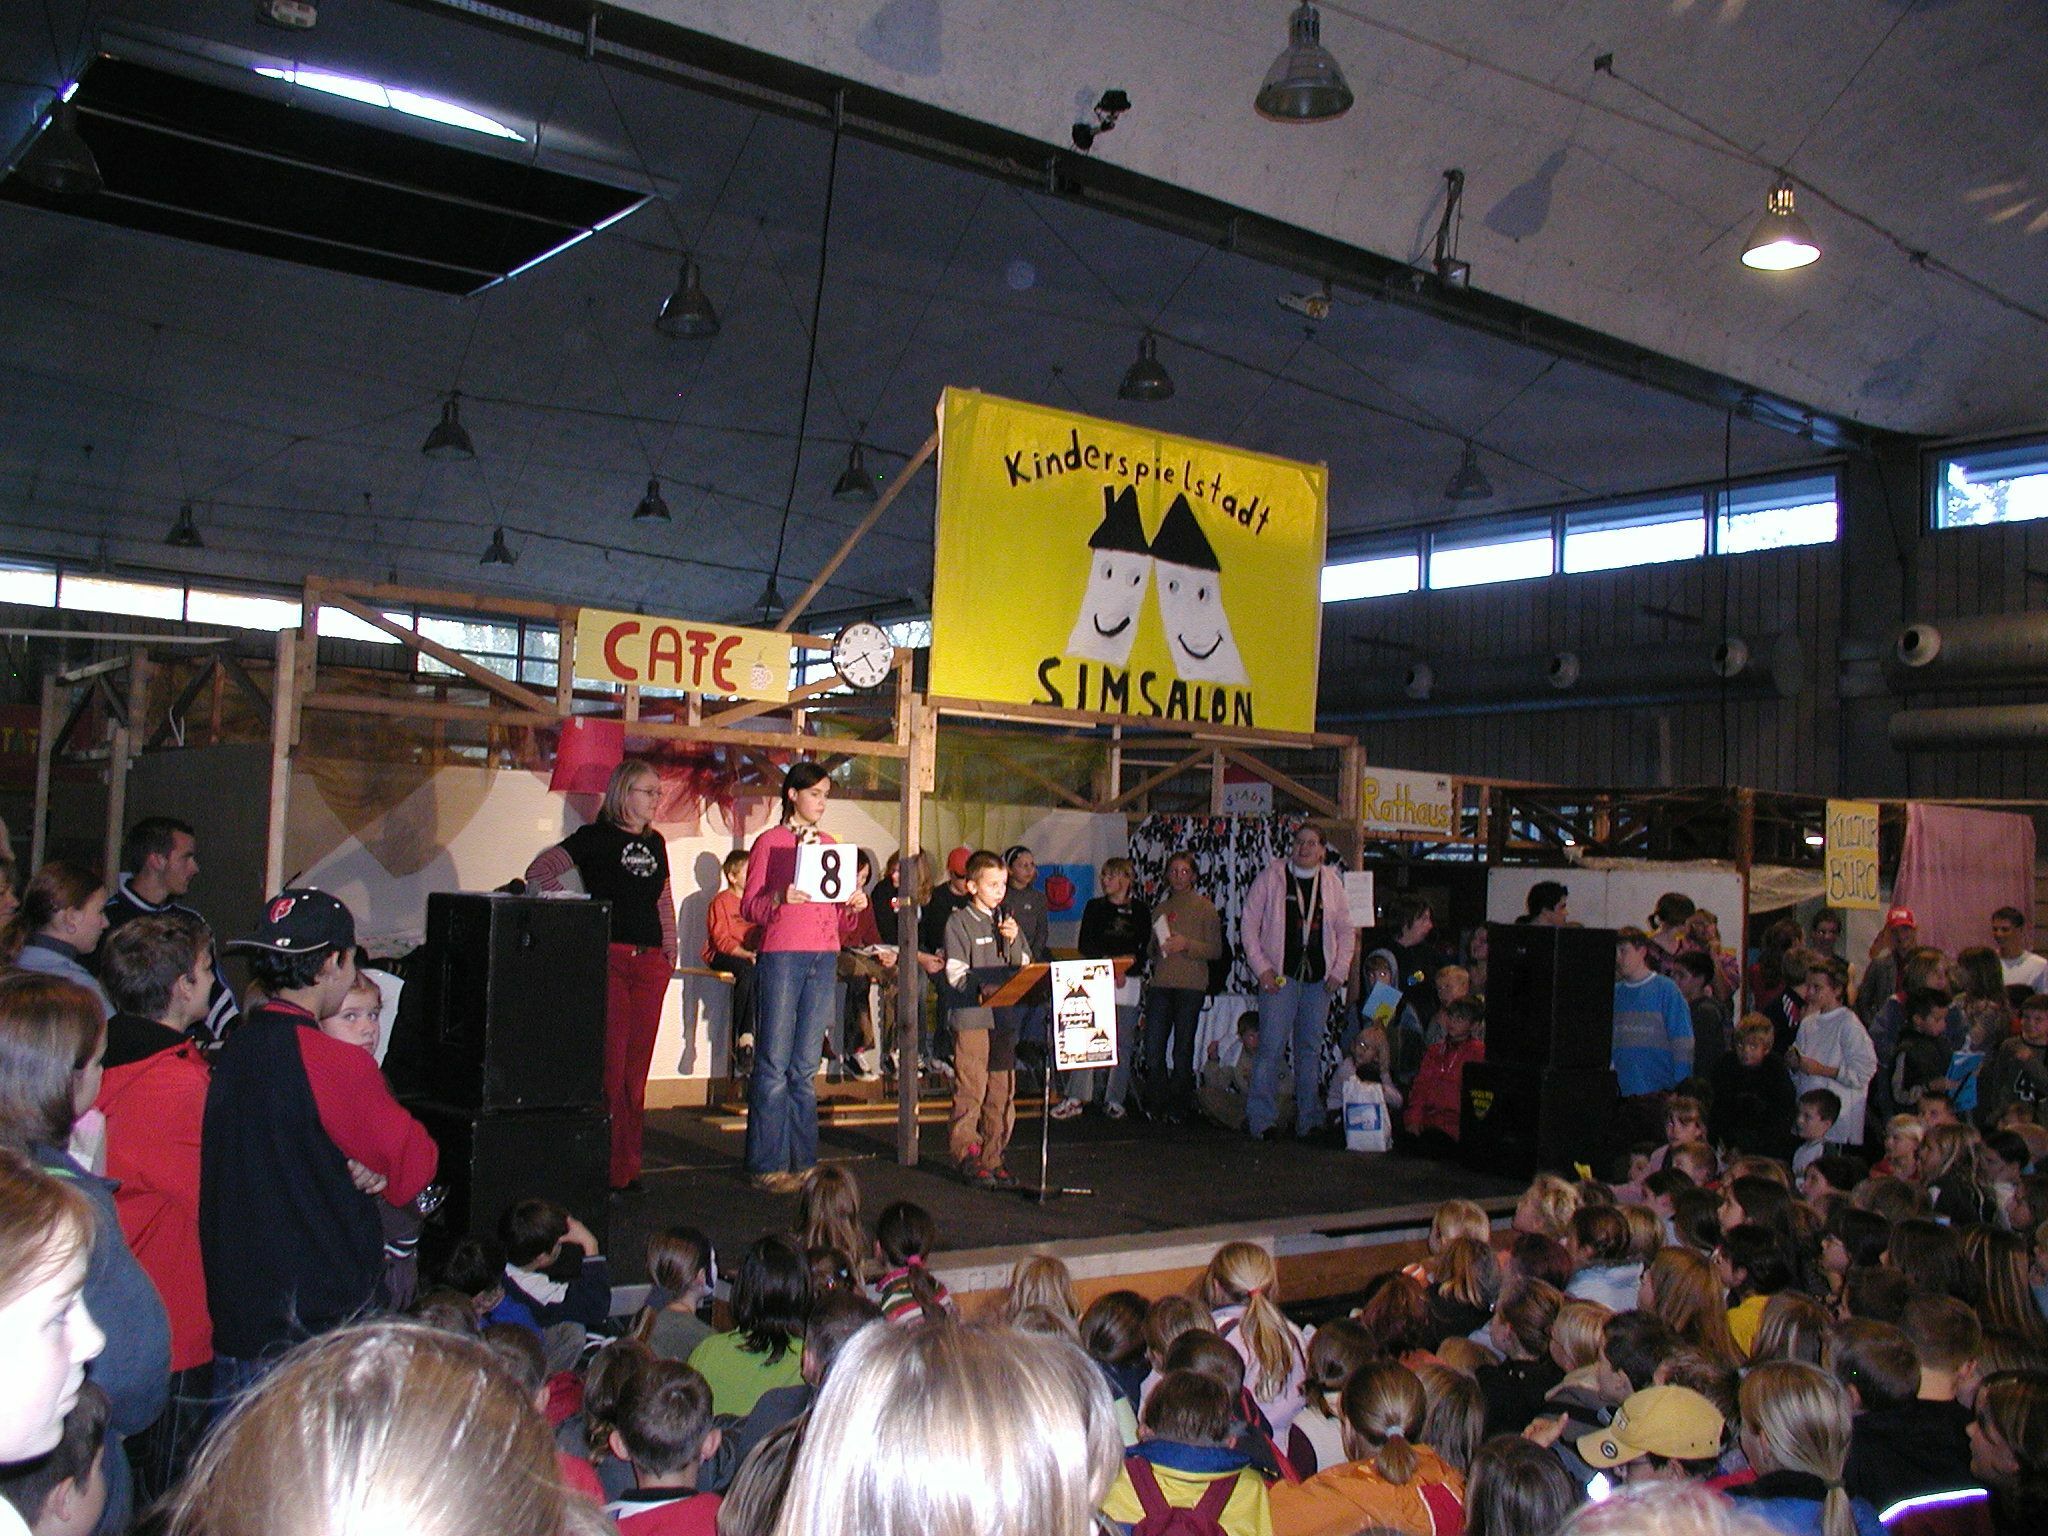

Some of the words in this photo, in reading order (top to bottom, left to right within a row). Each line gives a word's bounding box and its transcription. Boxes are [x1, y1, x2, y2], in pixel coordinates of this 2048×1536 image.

[1005, 429, 1271, 535] Kinderspielstadt
[604, 622, 743, 691] CAFE
[1032, 657, 1254, 728] SIMSALON
[1363, 778, 1449, 827] Rathaus
[820, 849, 841, 898] 8
[1829, 854, 1877, 900] BÜRO
